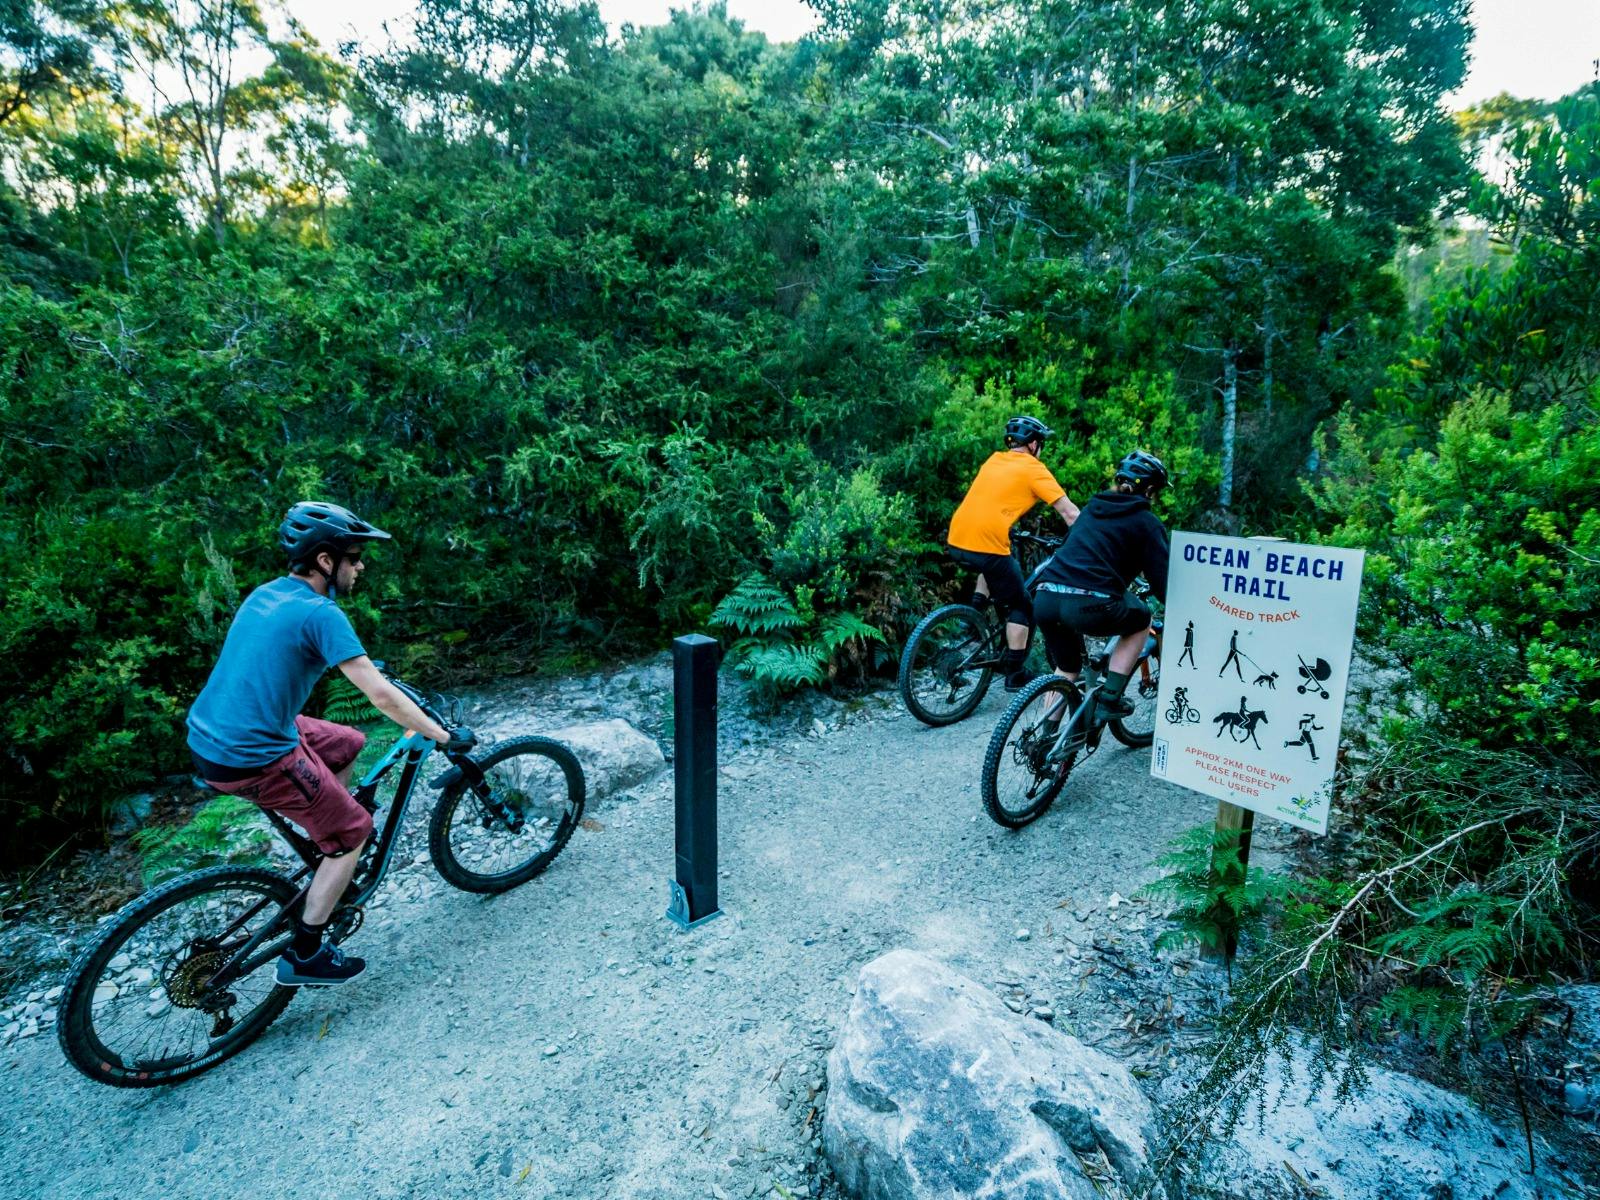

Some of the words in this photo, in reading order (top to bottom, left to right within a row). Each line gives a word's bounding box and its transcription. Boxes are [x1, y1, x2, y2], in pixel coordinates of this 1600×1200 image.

[1184, 543, 1250, 569] OCEAN
[1265, 552, 1344, 581] BEACH
[1222, 573, 1291, 601] TRAIL
[1208, 595, 1255, 621] SHARED
[1258, 609, 1301, 623] TRACK
[1184, 746, 1220, 763] APPROX
[1223, 757, 1243, 770] 2KM
[1246, 764, 1267, 777] ONE
[1269, 772, 1292, 785] WAY
[1195, 759, 1230, 777] PLEASE
[1232, 771, 1277, 791] RESPECT
[1208, 775, 1225, 786] ALL
[1227, 781, 1260, 797] USERS
